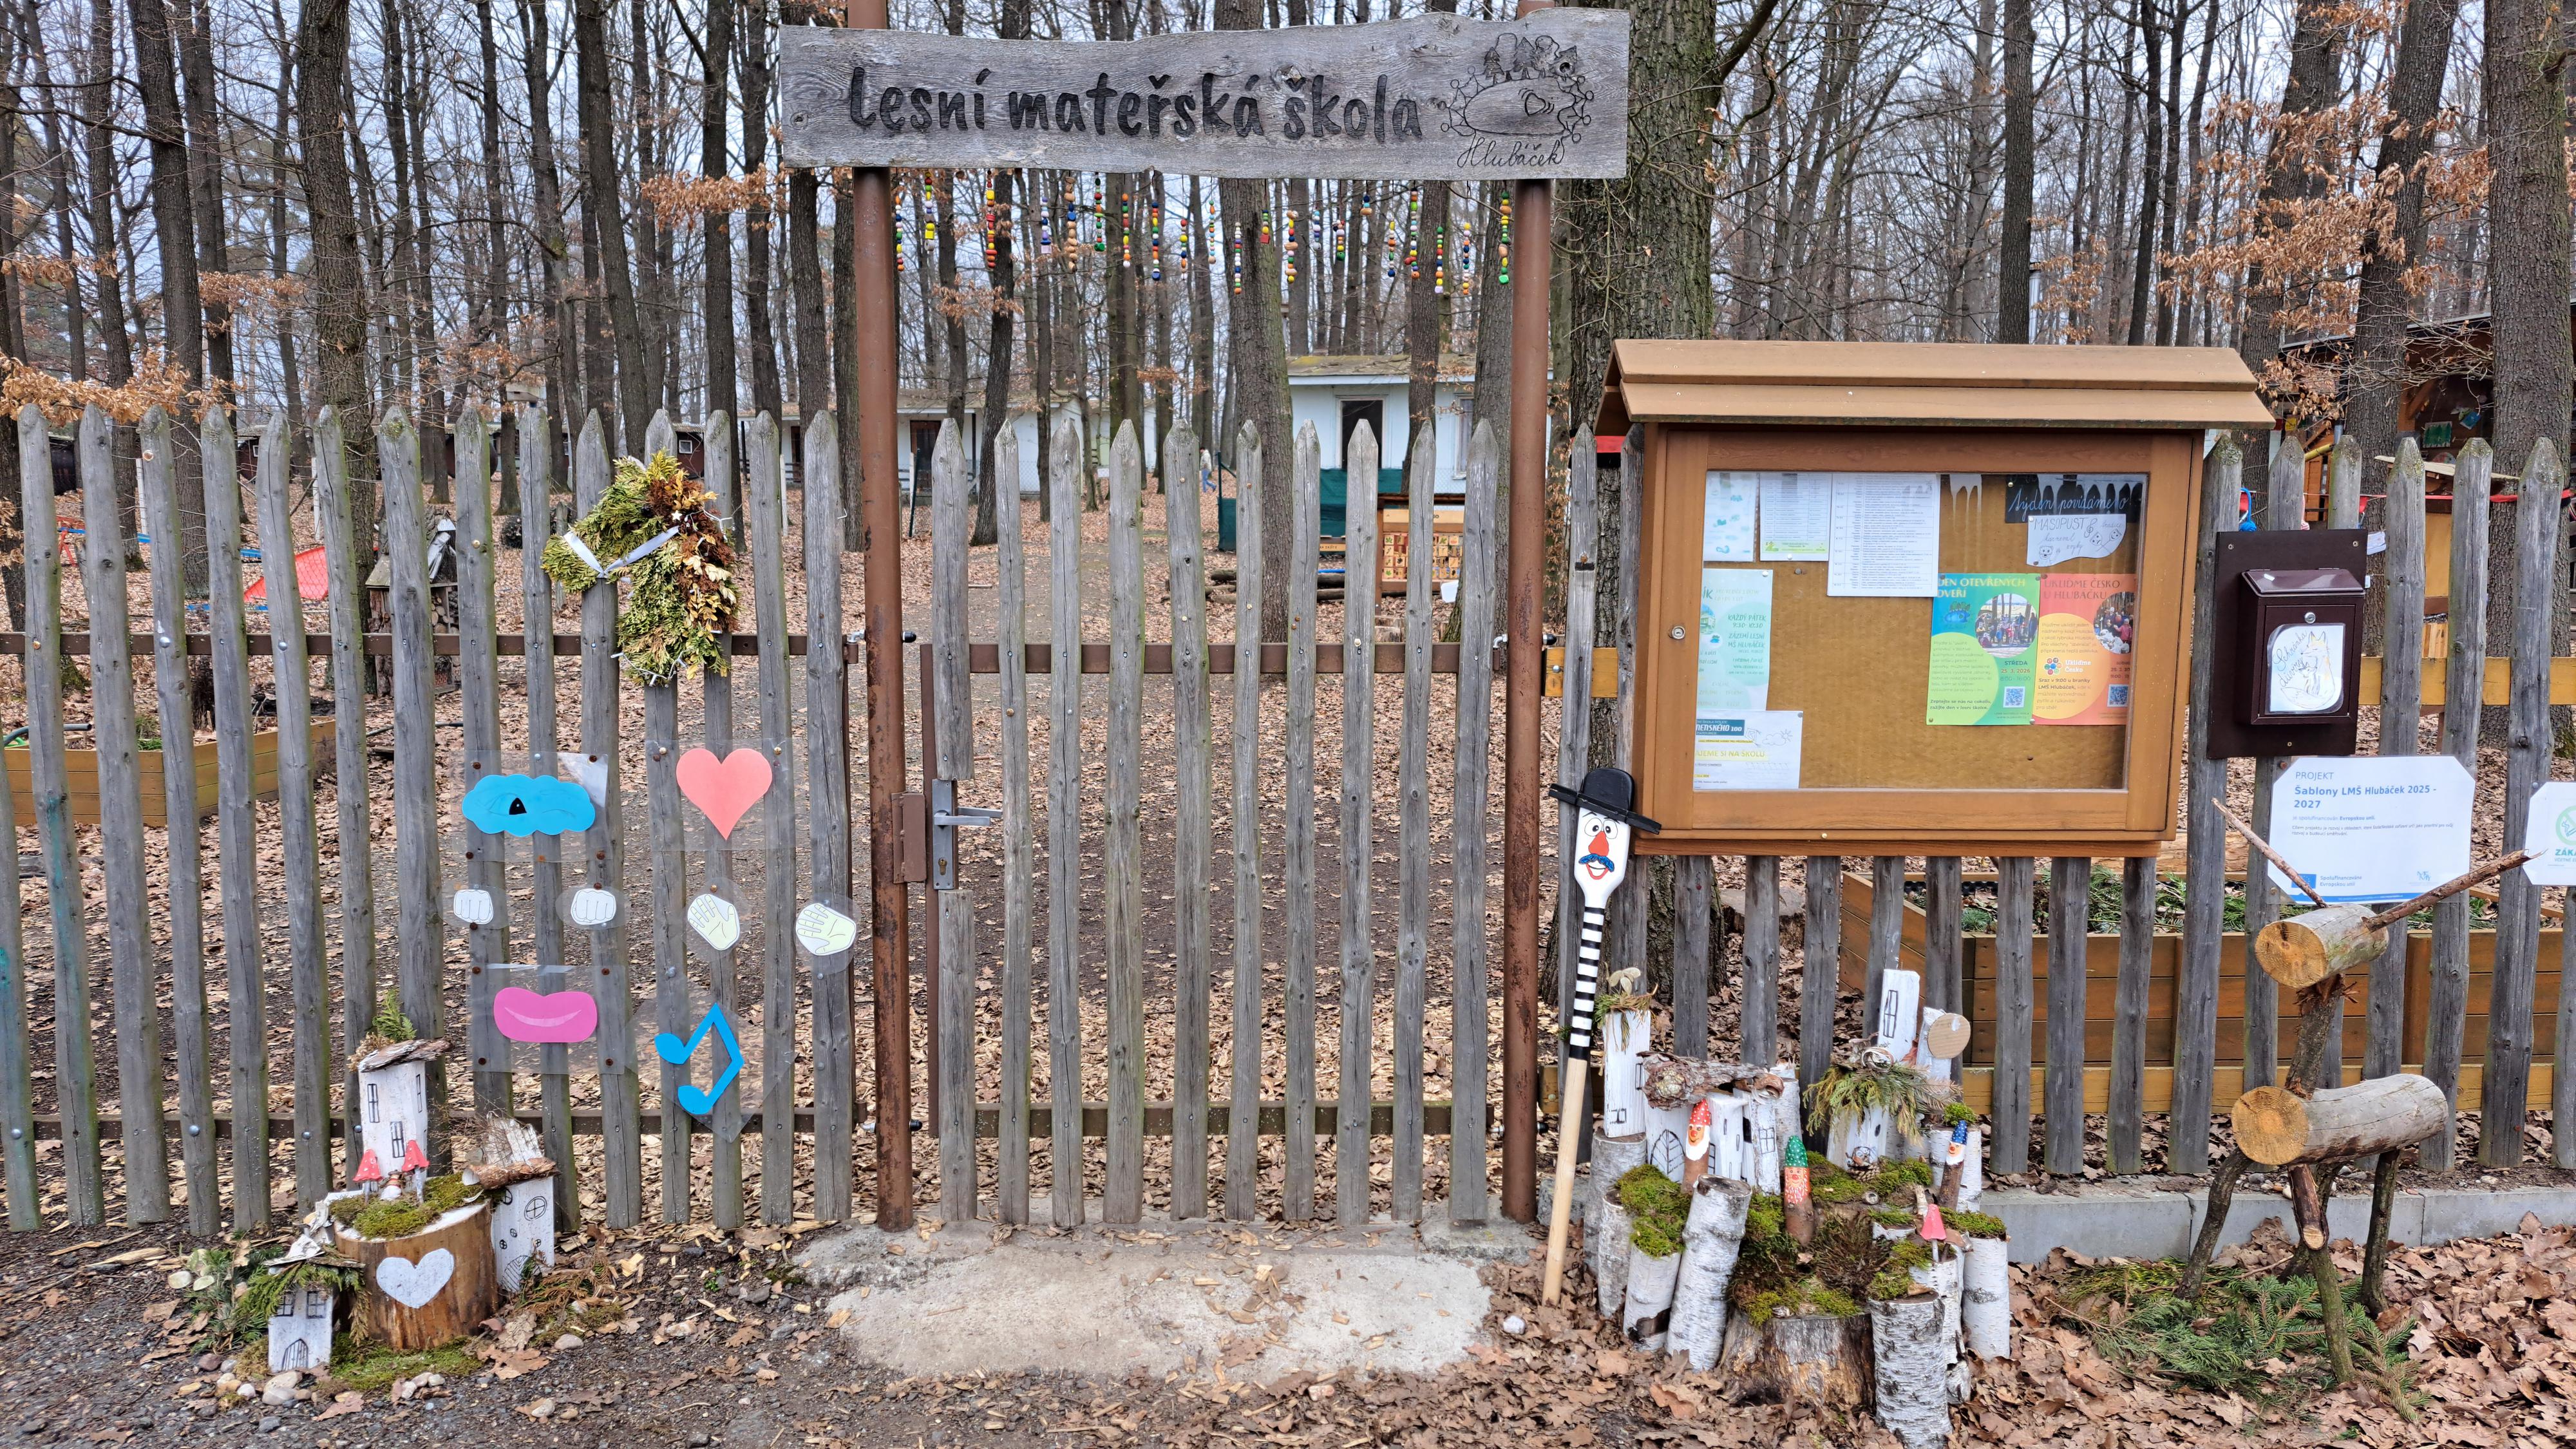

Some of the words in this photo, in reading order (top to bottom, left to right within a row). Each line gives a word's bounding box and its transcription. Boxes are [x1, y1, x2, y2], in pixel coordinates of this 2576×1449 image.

[850, 67, 992, 131] Lesní
[1009, 72, 1264, 139] mateřská
[1283, 73, 1423, 143] škola
[1457, 131, 1565, 168] Hlubáček
[2034, 517, 2088, 532] MASOPUST
[1938, 578, 1956, 587] DEN
[1960, 576, 2026, 587] OTEVŘENÝCH
[2090, 578, 2120, 589] ČESKO
[1937, 587, 1967, 598] DVEŘÍ
[2054, 589, 2107, 599] HLUBÁČKU
[1741, 749, 1765, 757] ŠKOLU
[2295, 772, 2334, 781] PROJEKT
[2295, 784, 2338, 798] Šablony
[2342, 784, 2362, 796] LMŠ
[2365, 784, 2405, 795] Hlubáček
[2407, 784, 2430, 794] 2025
[2293, 799, 2321, 809] 2027
